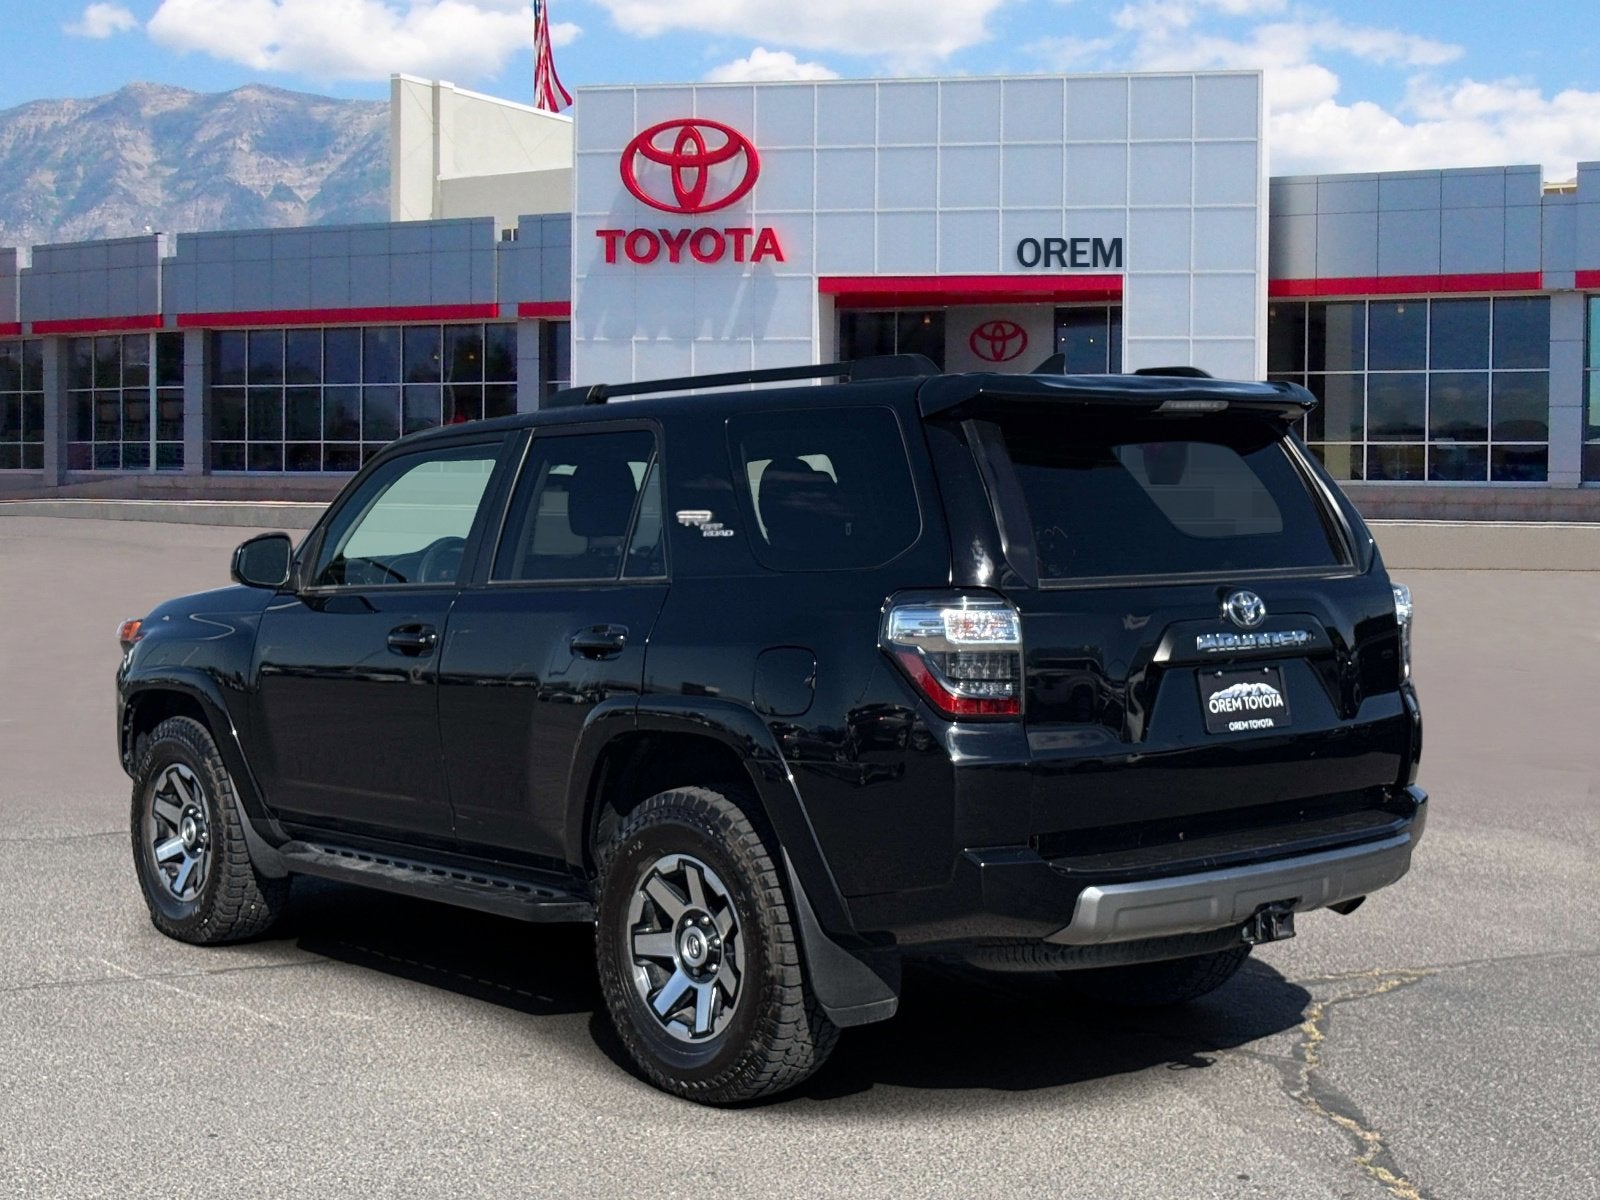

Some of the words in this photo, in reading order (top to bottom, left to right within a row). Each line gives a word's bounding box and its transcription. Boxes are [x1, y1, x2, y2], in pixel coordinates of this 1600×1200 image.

[596, 227, 784, 264] TOYOTA
[1016, 237, 1123, 268] OREM
[1209, 697, 1243, 713] OREM
[1243, 693, 1284, 710] TOYOTA
[1228, 721, 1250, 731] OREM
[1249, 718, 1275, 729] TOYOTA
